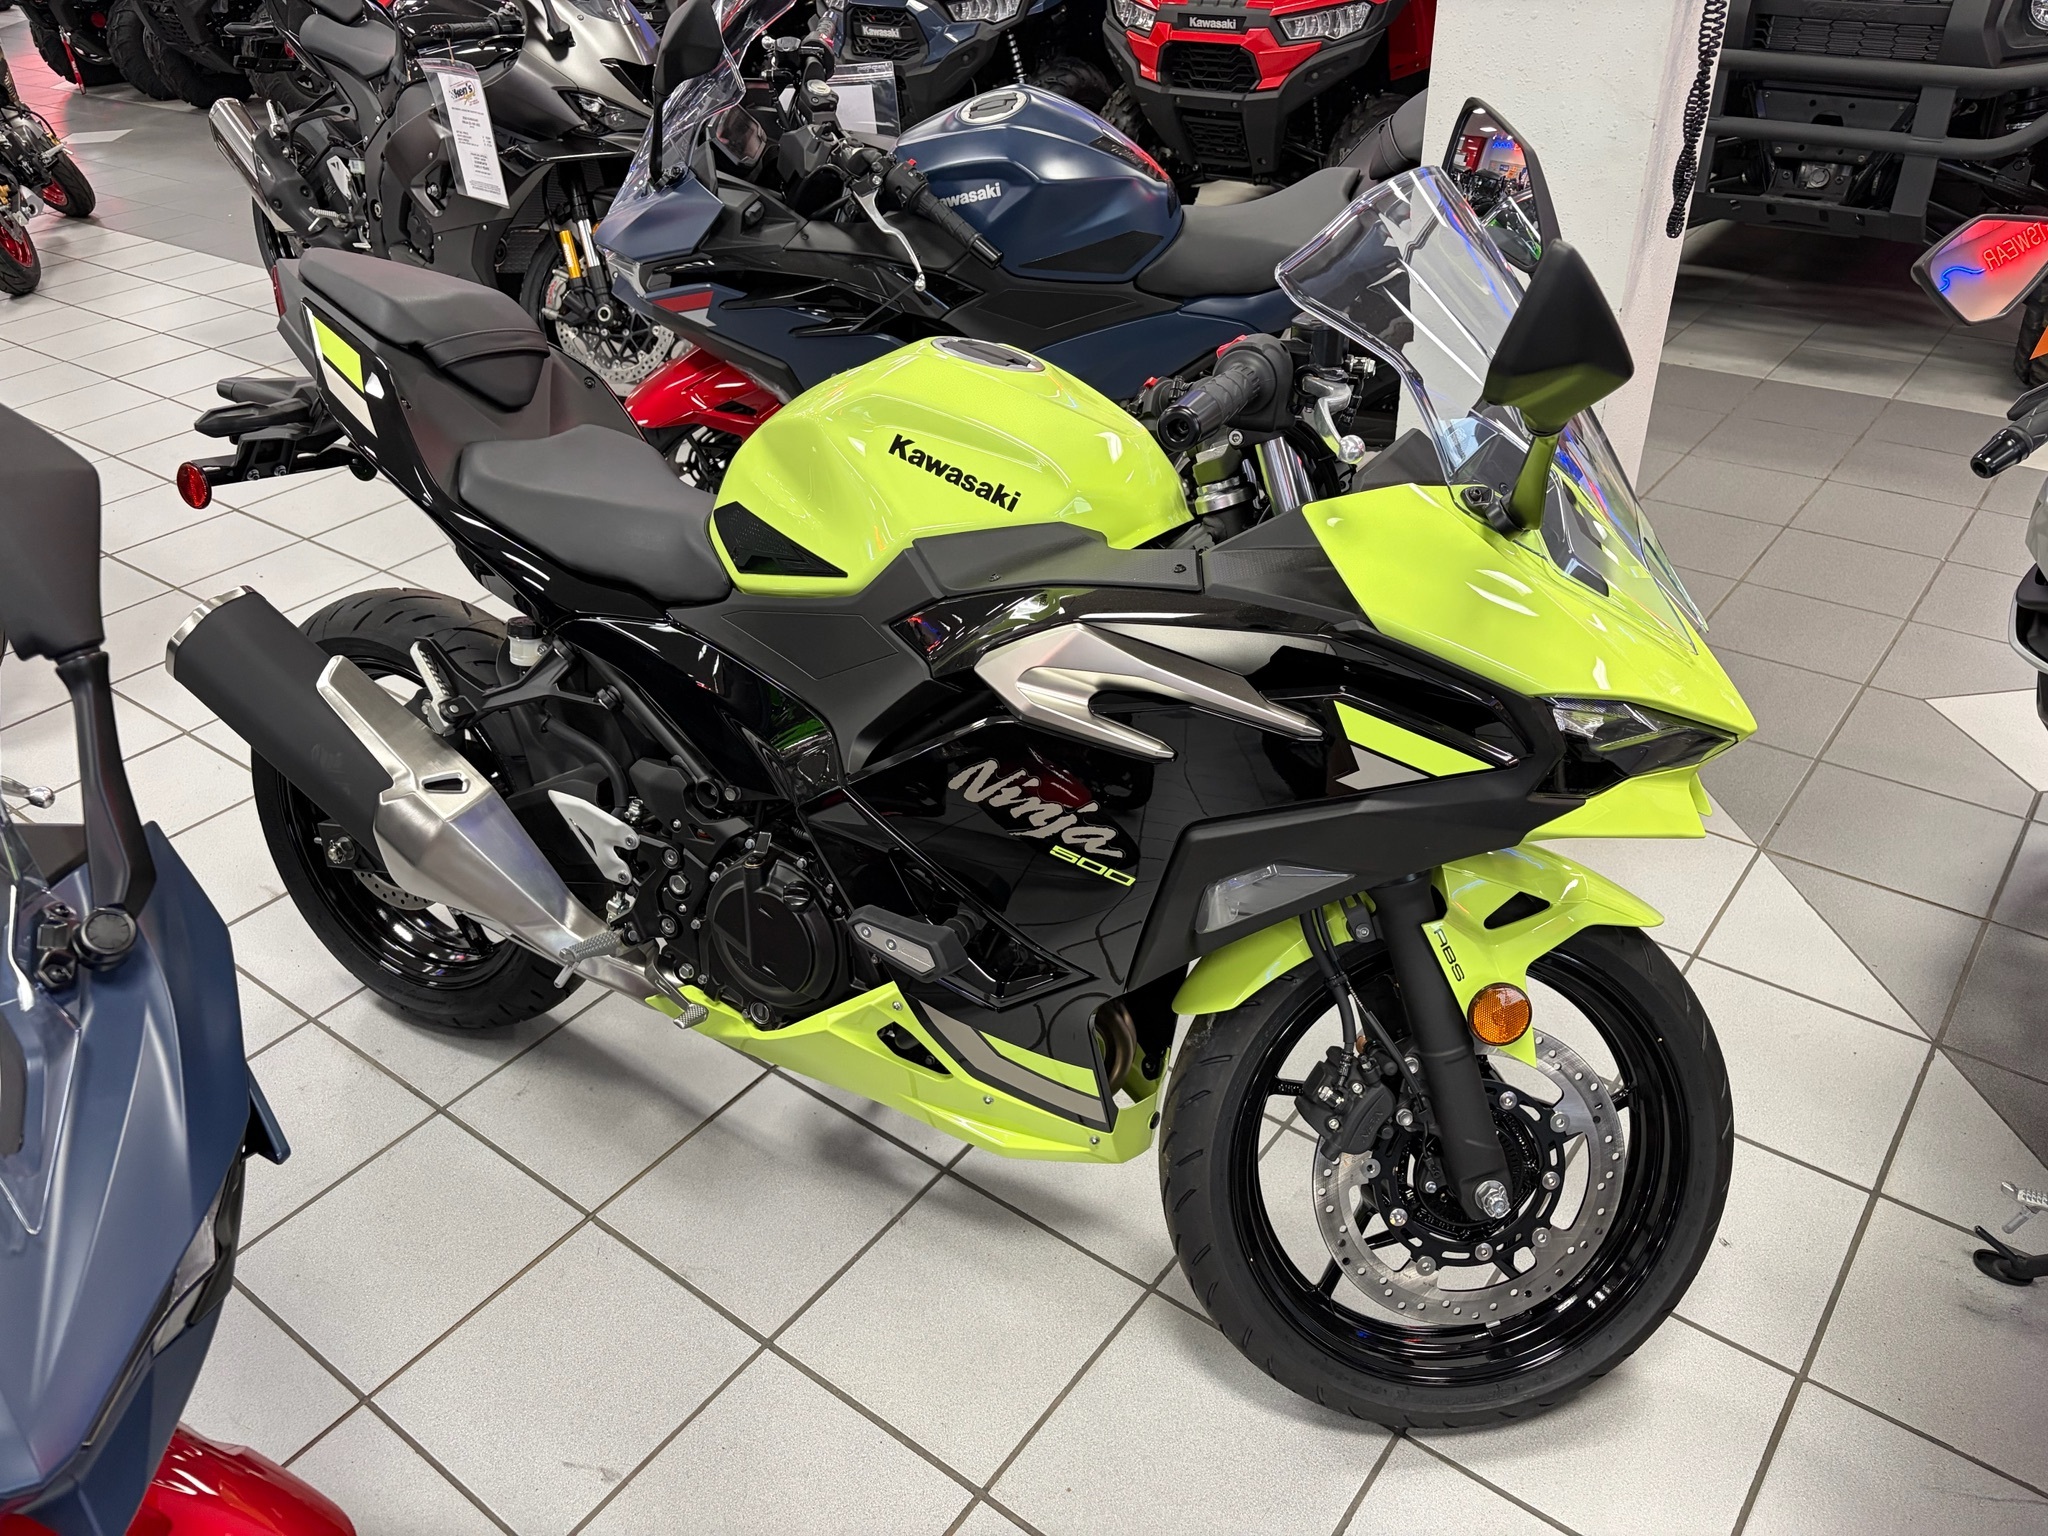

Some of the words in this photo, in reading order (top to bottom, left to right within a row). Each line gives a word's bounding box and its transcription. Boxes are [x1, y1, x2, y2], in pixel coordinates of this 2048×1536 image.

[862, 25, 900, 38] Kawasaki
[1189, 16, 1237, 30] Kawasaki
[938, 182, 1003, 208] awasaki
[888, 433, 1022, 513] Kawasaki
[947, 758, 1124, 859] Ninja
[1049, 845, 1137, 887] 500
[1433, 927, 1465, 982] ABS
